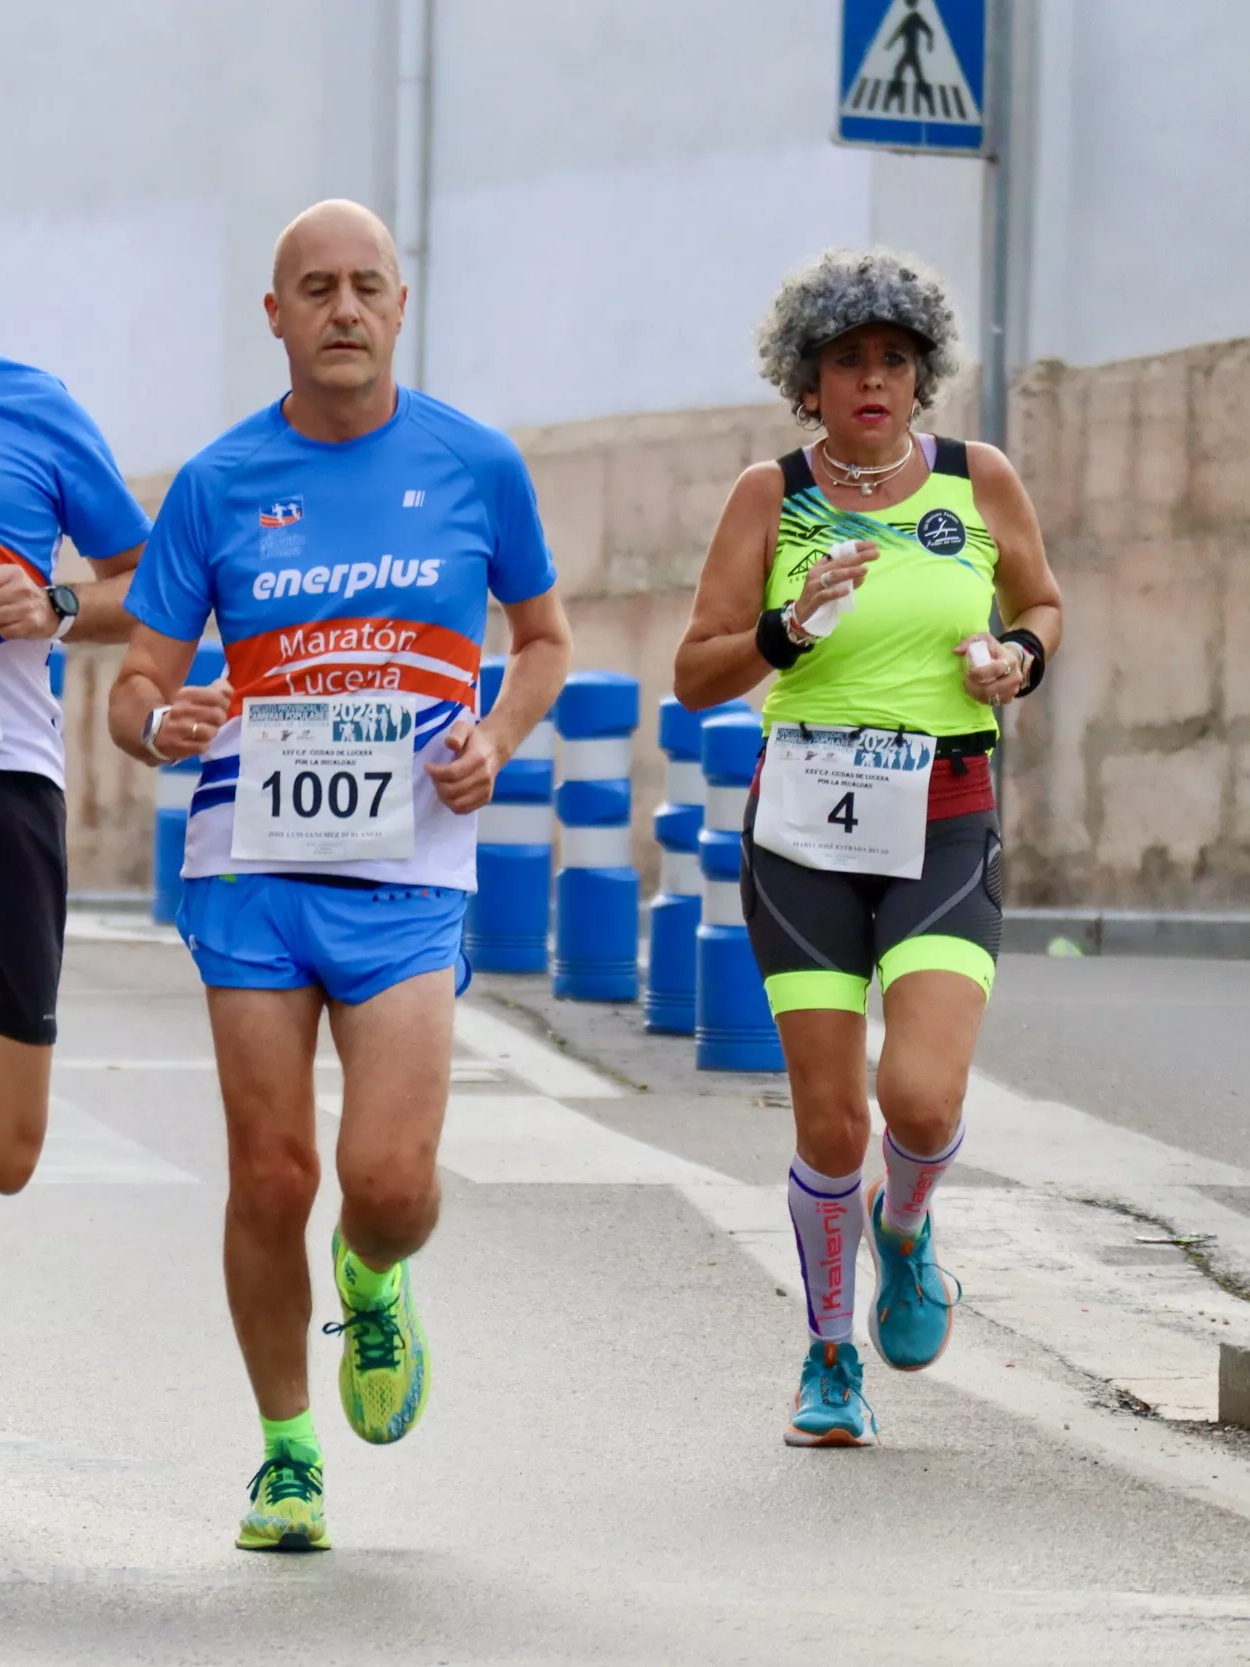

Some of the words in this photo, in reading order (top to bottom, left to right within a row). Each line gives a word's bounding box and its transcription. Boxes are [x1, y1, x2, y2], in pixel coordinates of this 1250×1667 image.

[252, 554, 441, 600] enerplus
[279, 621, 418, 659] Maratón
[285, 665, 402, 696] Lucena
[331, 702, 378, 723] 2024
[309, 749, 335, 757] CIUDAD
[261, 770, 393, 819] 1007
[831, 770, 855, 778] CIUDAD
[865, 774, 890, 782] LUCENA
[827, 791, 859, 834] 4
[815, 1201, 848, 1311] Kalenji
